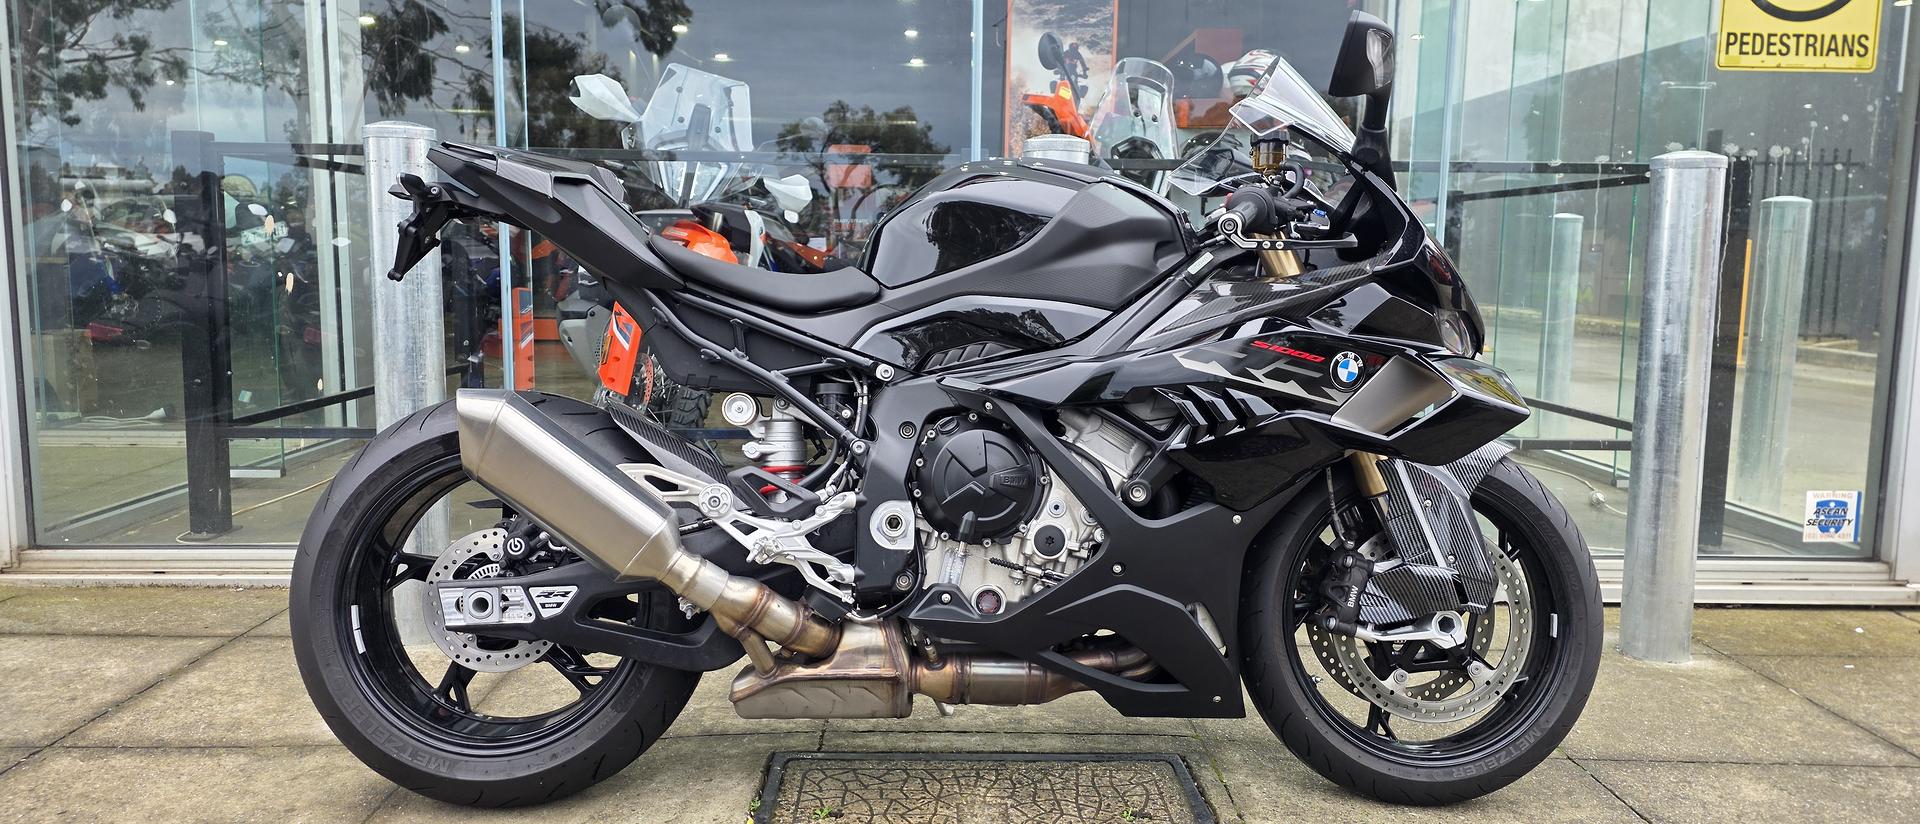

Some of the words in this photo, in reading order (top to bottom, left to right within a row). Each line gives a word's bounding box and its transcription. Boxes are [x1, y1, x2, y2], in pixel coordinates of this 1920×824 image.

[1725, 32, 1870, 58] PEDESTRIANS
[1250, 340, 1326, 363] S1000
[1806, 518, 1854, 526] SECURITY
[1347, 584, 1359, 608] BMW
[343, 694, 451, 774] METZELER
[1452, 726, 1542, 778] METZELER
